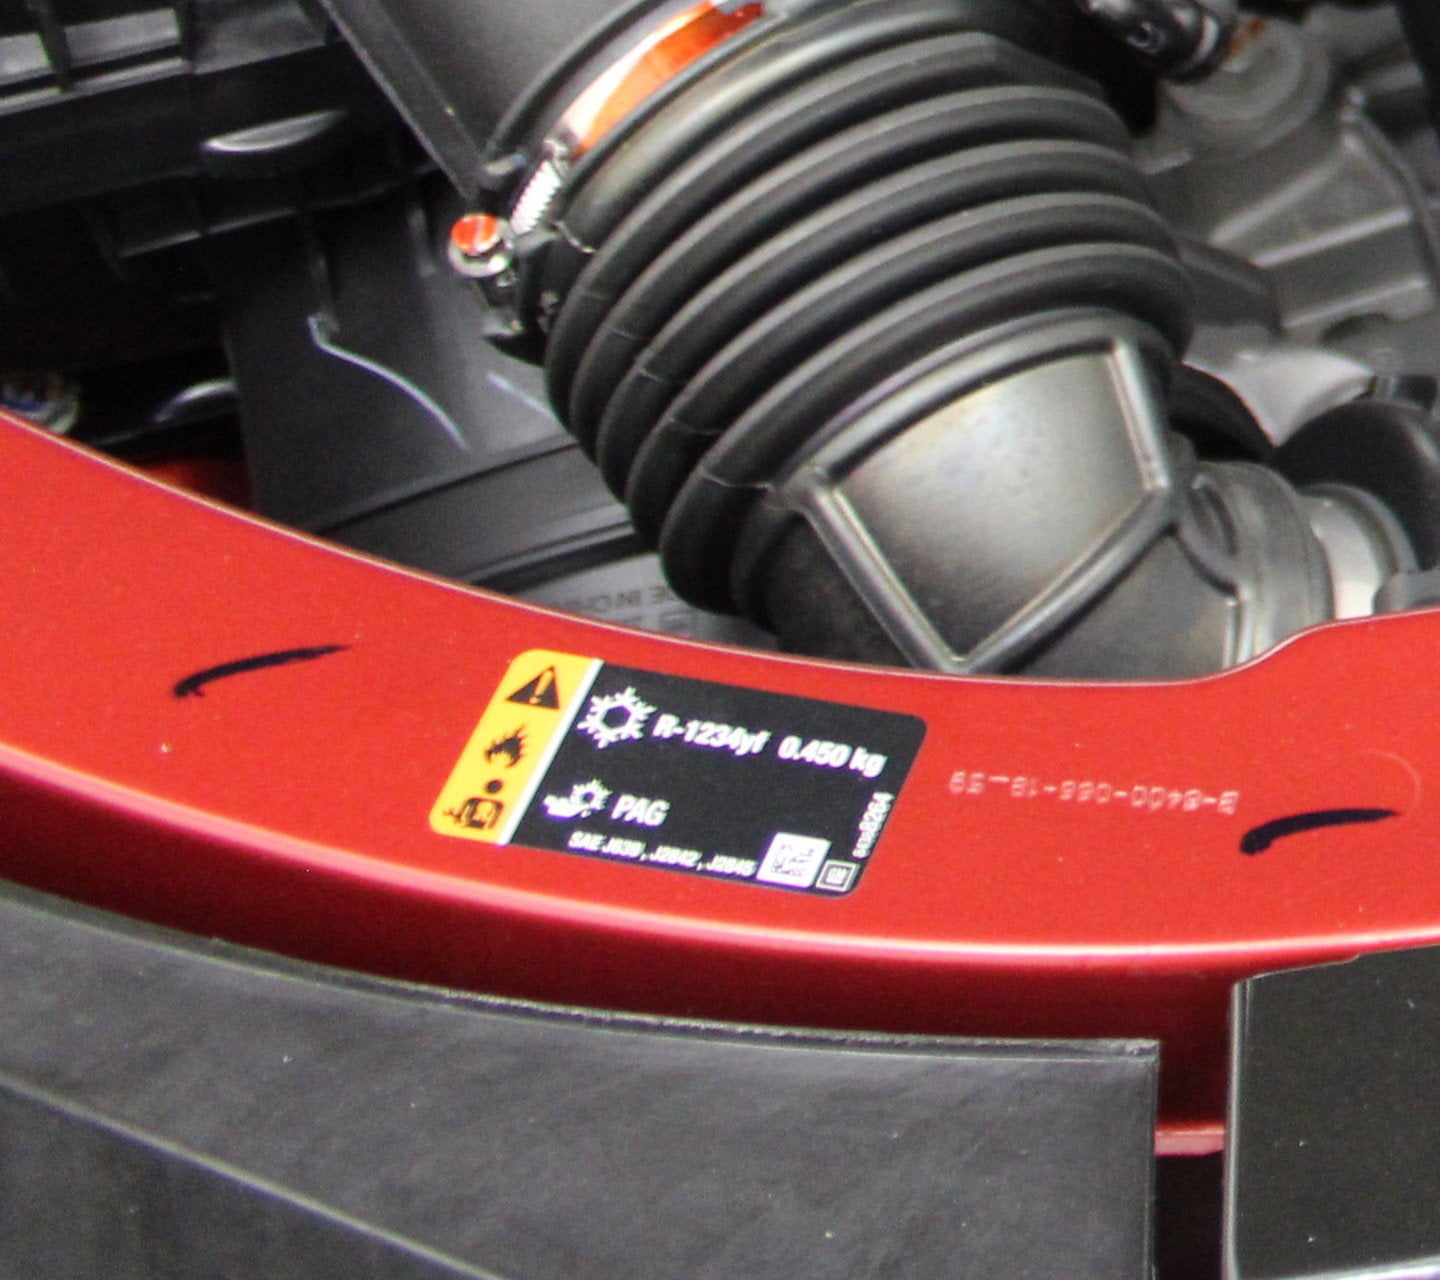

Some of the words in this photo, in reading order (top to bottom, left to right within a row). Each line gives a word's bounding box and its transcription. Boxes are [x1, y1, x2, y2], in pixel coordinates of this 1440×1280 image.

[652, 713, 771, 757] R-1234yf
[778, 735, 852, 769] 0.450
[849, 746, 889, 779] kg
[611, 794, 671, 827] PAG
[568, 830, 606, 852] SAE
